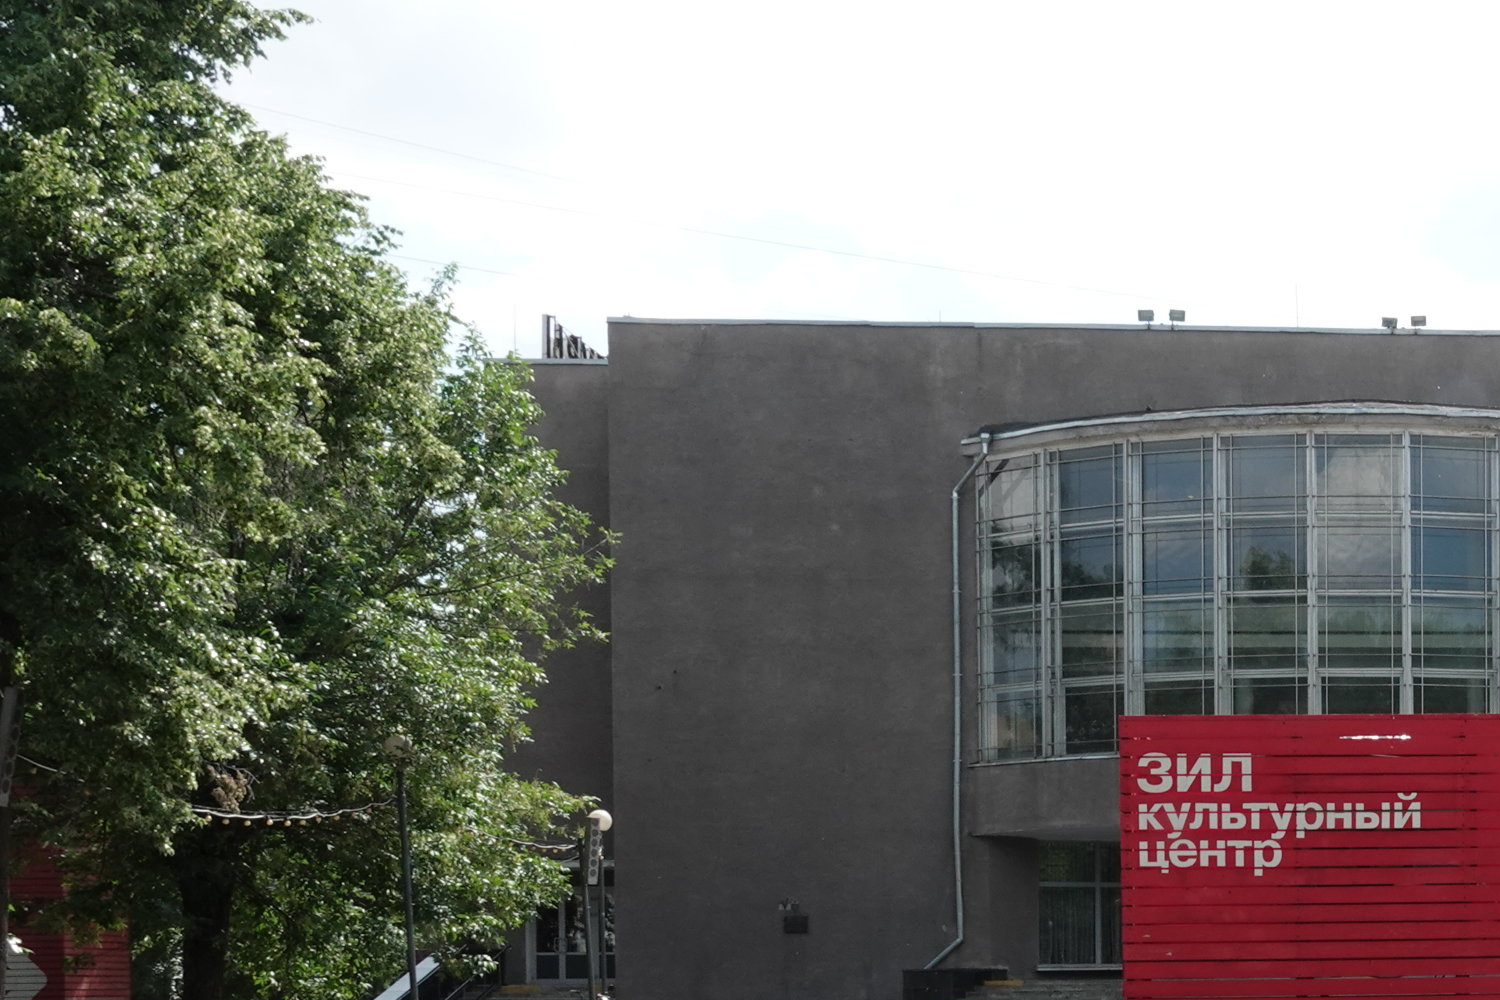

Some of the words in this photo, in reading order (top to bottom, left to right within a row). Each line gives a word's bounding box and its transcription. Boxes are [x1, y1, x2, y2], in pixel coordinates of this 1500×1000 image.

[1136, 752, 1253, 794] ЗИЛ
[1138, 792, 1422, 839] культурный
[1138, 839, 1284, 877] центр
